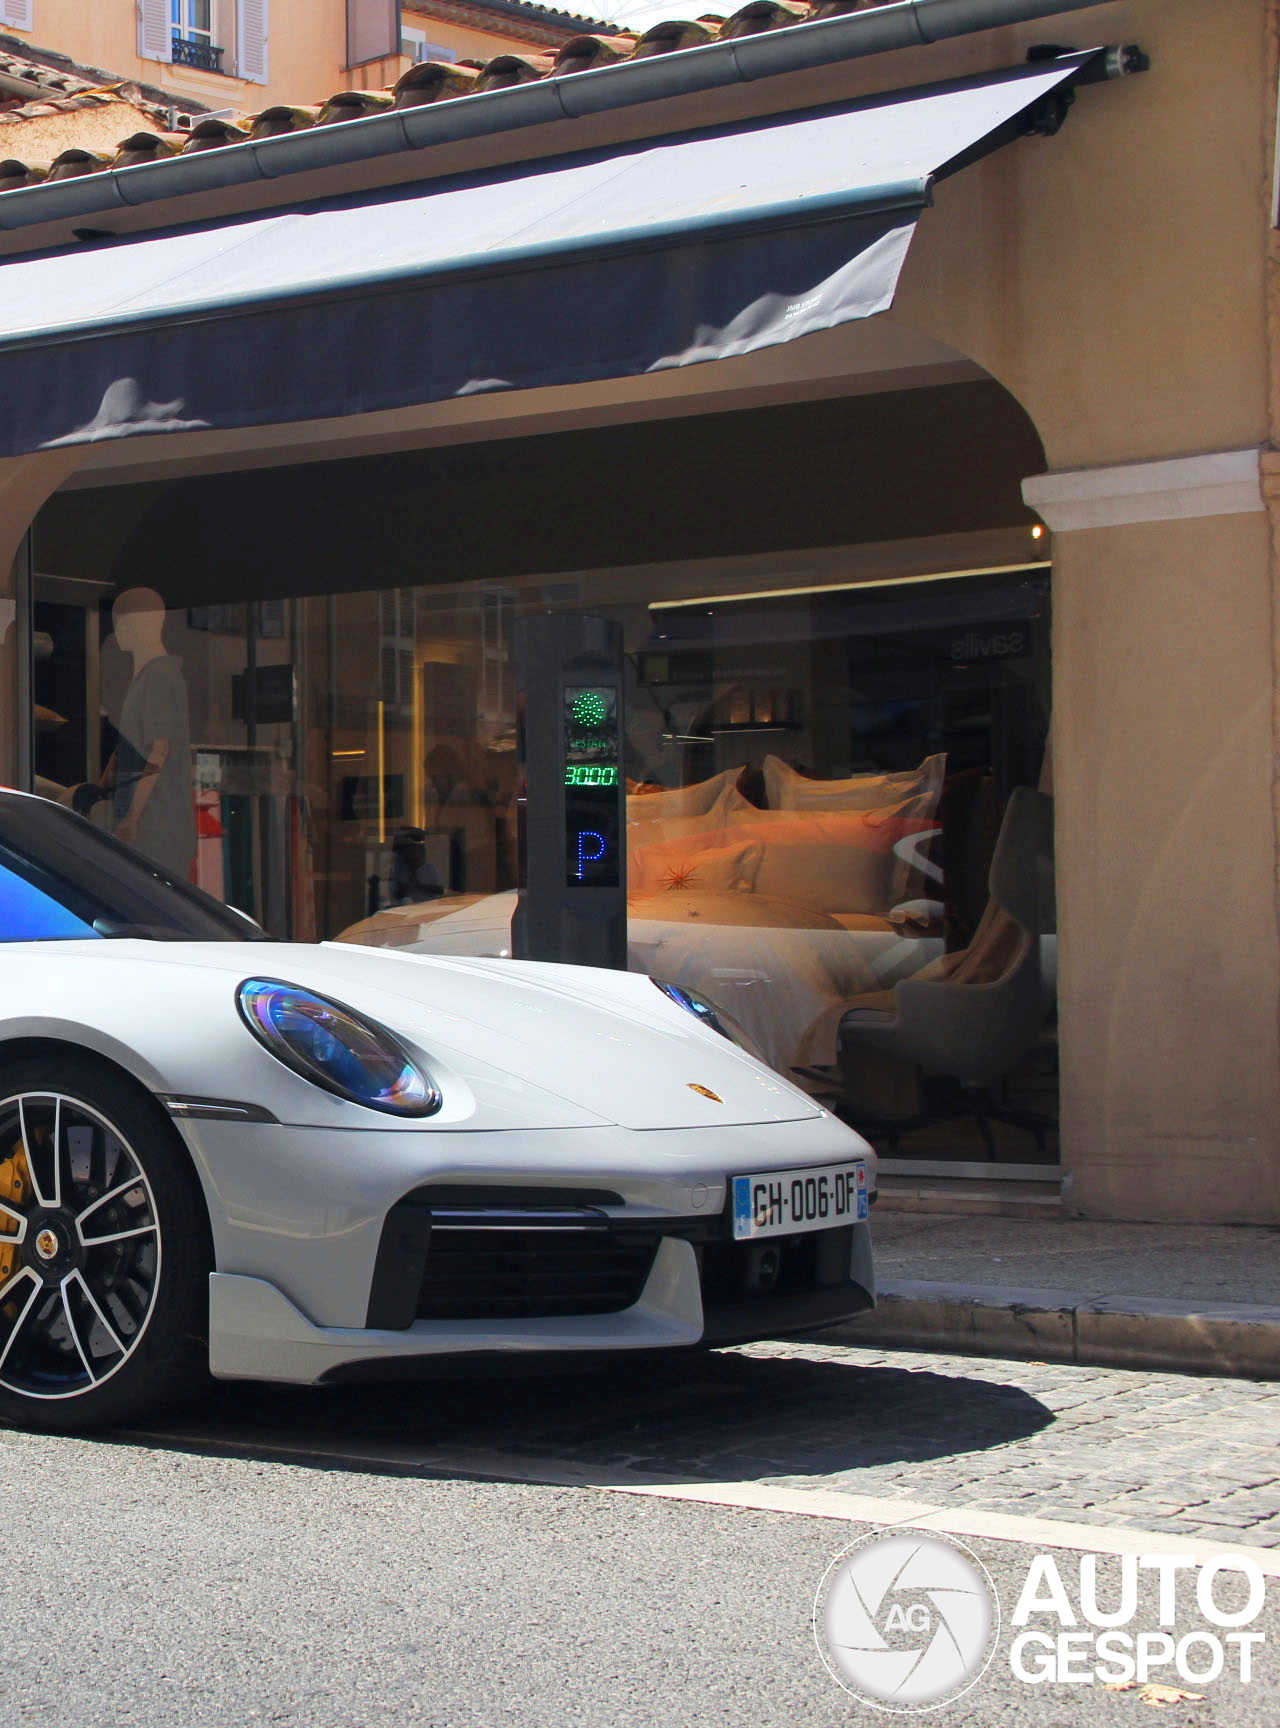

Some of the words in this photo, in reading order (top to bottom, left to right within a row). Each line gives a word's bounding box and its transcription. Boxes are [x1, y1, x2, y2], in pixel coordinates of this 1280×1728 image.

[564, 765, 615, 786] 3000
[578, 831, 606, 880] P
[753, 1171, 855, 1227] GH-006-DF
